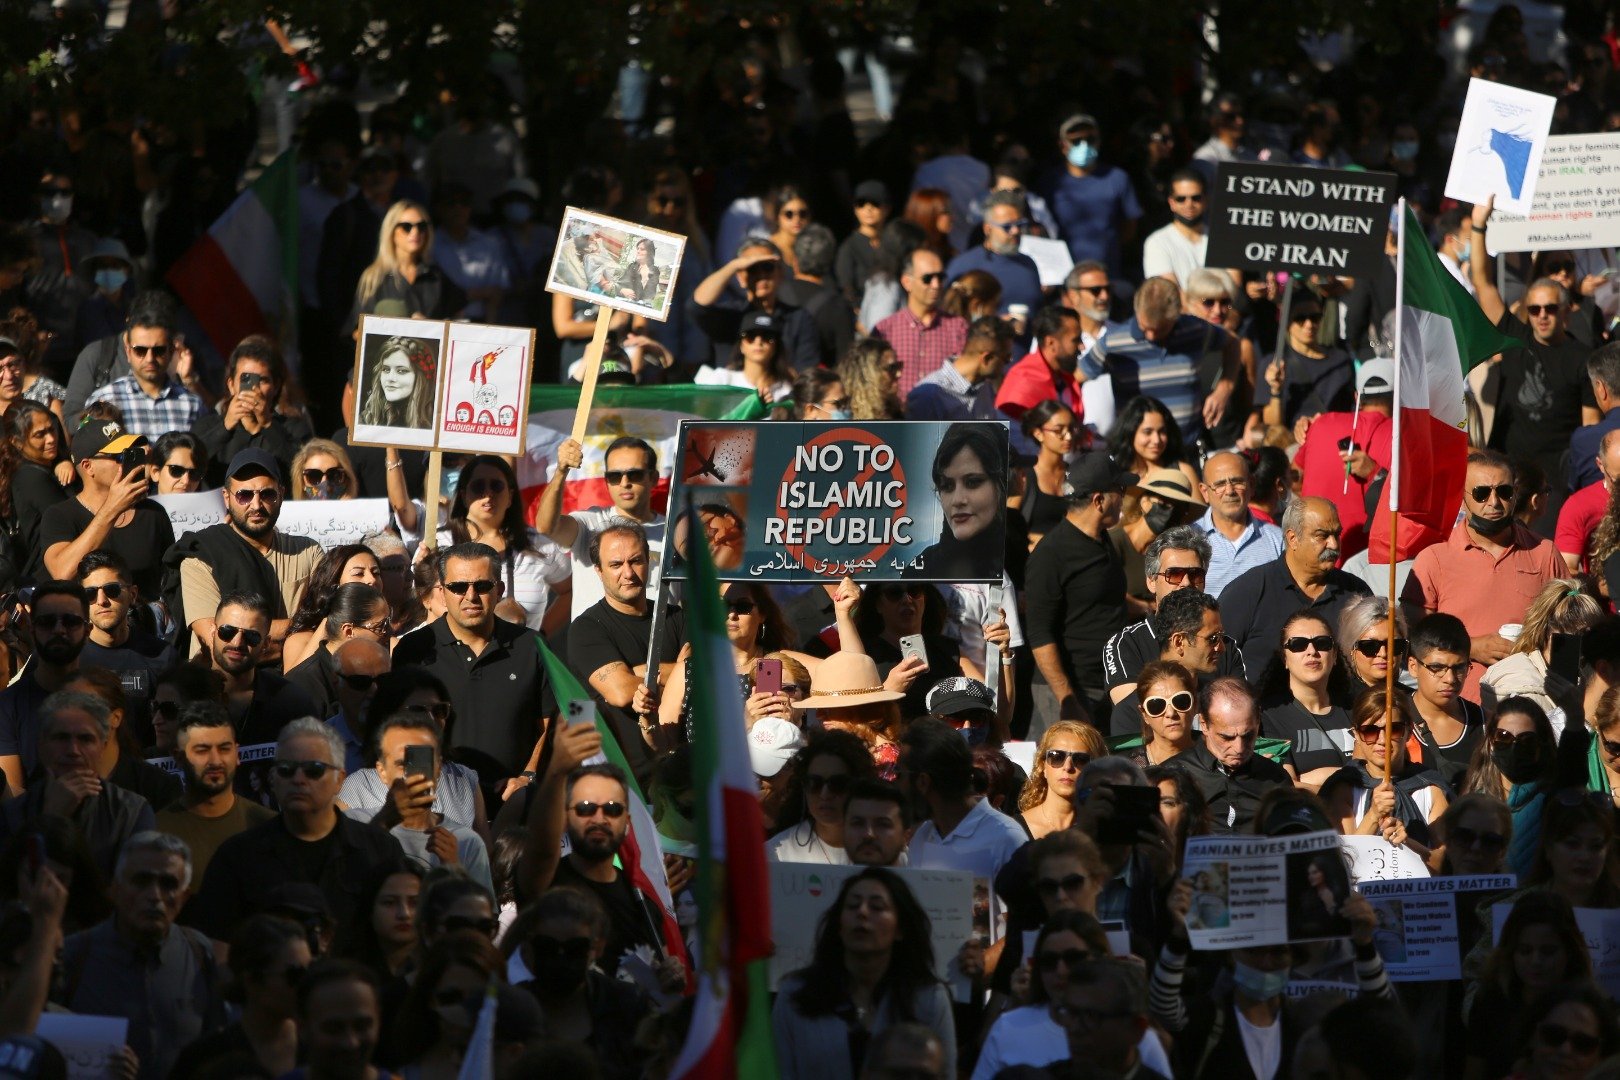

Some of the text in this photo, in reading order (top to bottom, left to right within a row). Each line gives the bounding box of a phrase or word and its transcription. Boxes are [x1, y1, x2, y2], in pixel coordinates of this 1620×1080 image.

[1574, 155, 1602, 164] rights
[1226, 175, 1387, 204] I STAND WITH
[1568, 188, 1594, 197] earth
[1226, 207, 1374, 235] THE WOMEN
[1565, 209, 1594, 222] rights
[1244, 242, 1349, 269] OF IRAN
[446, 422, 515, 436] ENOUGH IS ENOUGH
[794, 444, 895, 473] NO TO
[780, 480, 904, 509] ISLAMIC
[764, 517, 914, 545] REPUBLIC
[750, 551, 925, 577] نه به جمهوری اسلامی
[1187, 834, 1337, 857] IRANIAN LIVES MATTER
[1359, 876, 1512, 896] IRANIAN LIVES MATTER
